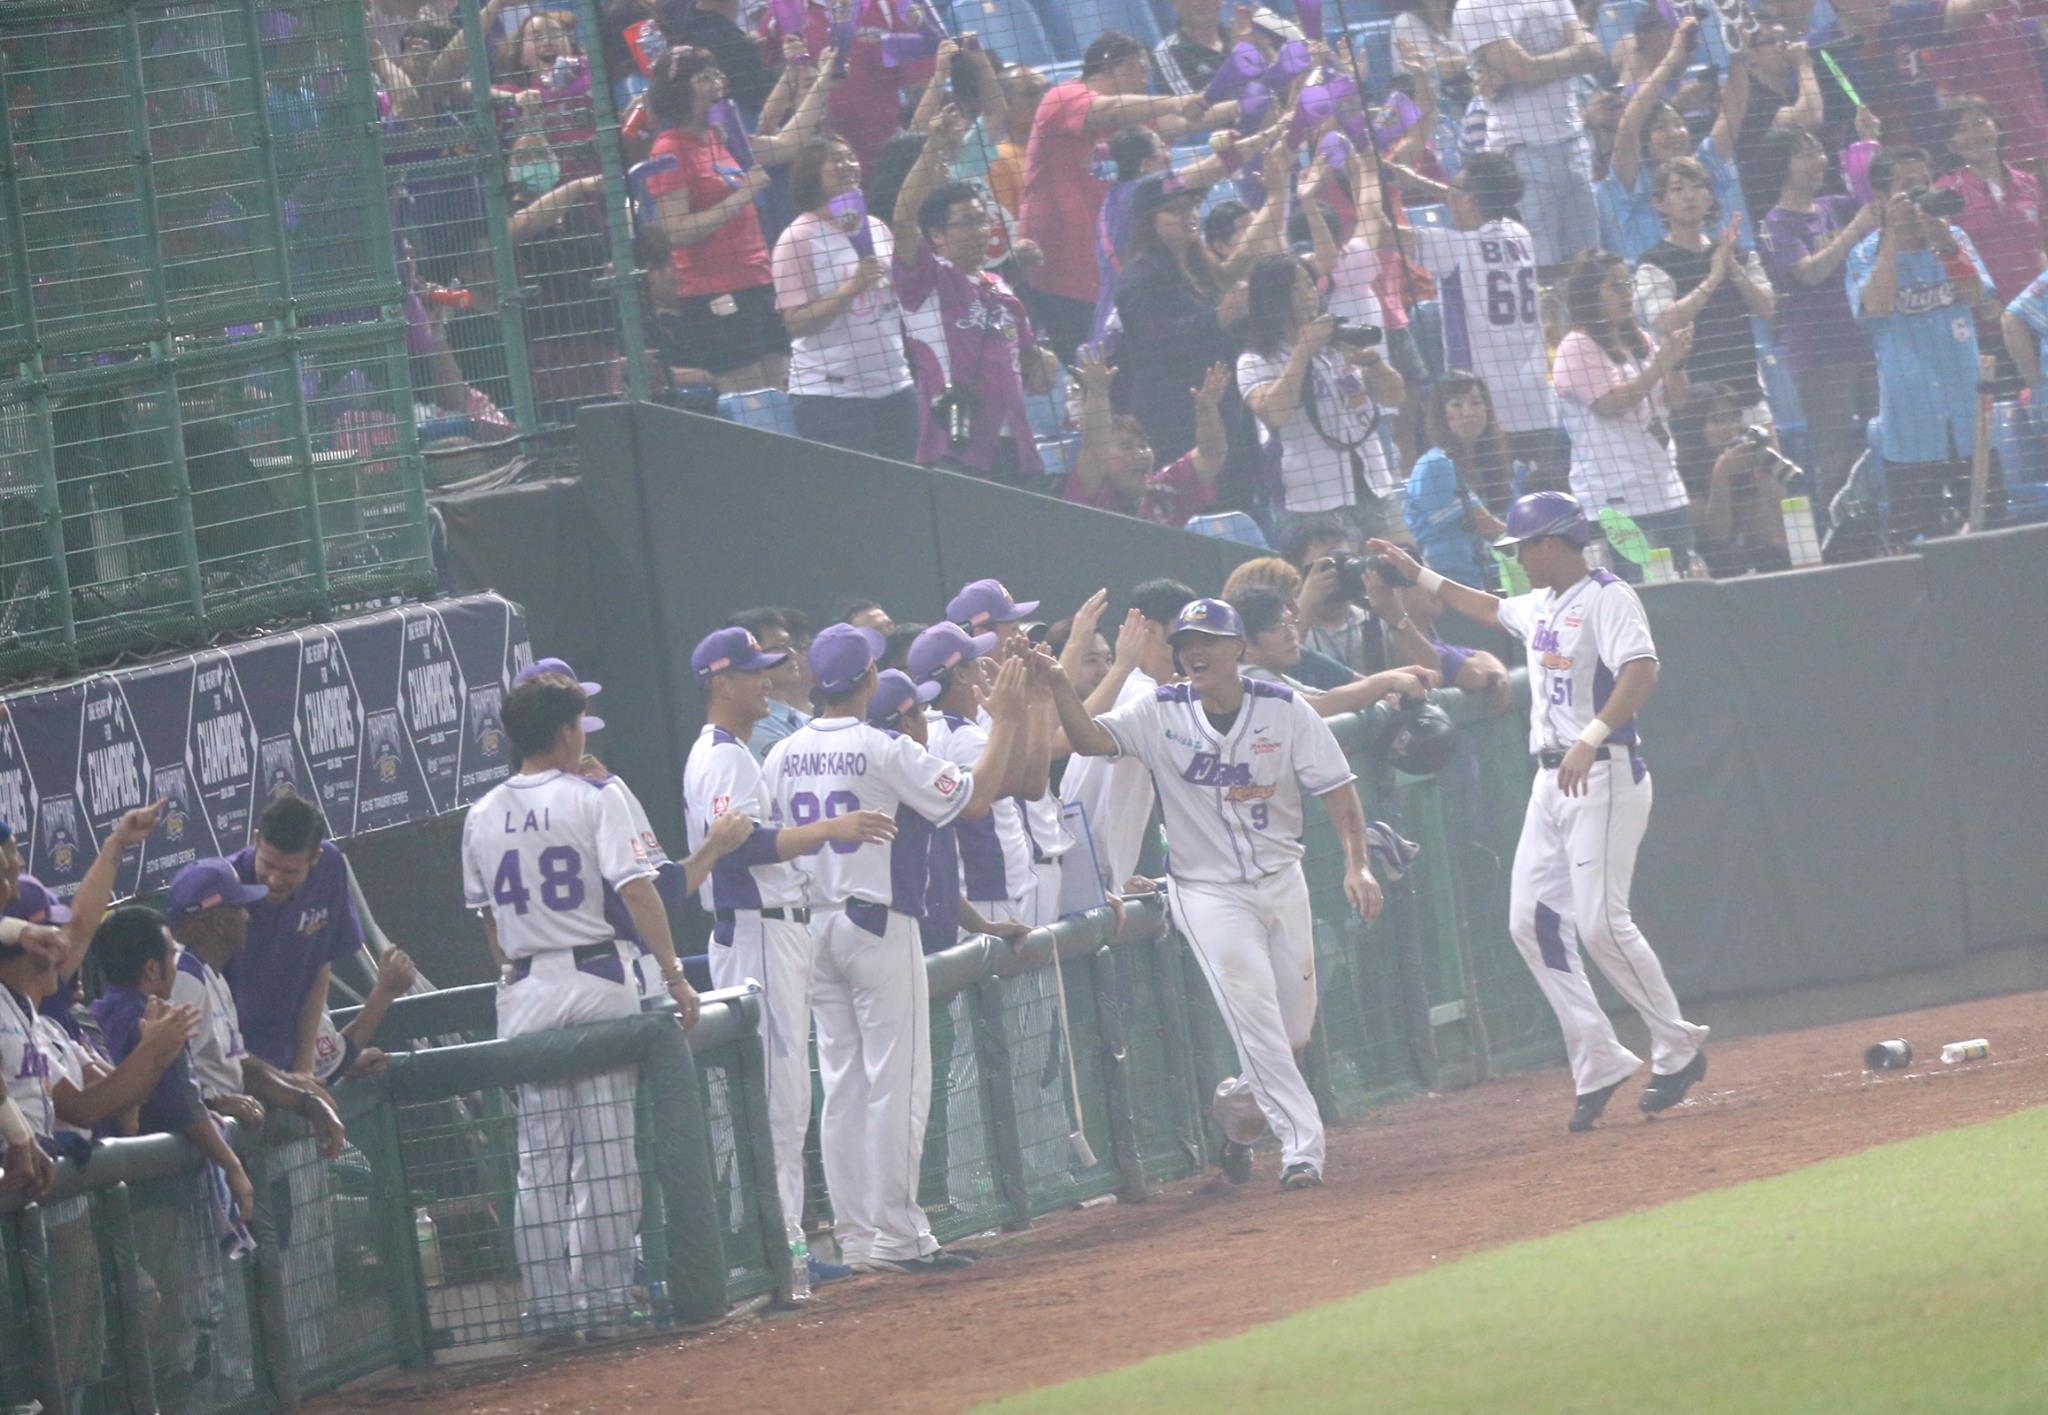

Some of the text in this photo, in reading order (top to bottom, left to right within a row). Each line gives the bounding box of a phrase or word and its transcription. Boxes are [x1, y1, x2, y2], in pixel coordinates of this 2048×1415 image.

[305, 685, 354, 755] CHAMPIONS
[408, 661, 457, 731] CHAMPIONS
[1551, 677, 1573, 707] 51
[88, 741, 141, 816] CHAMPIONS
[197, 712, 248, 785] CHAMPIONS
[783, 752, 867, 778] ARANGKARO
[505, 807, 550, 834] LAI
[1251, 802, 1269, 831] 9
[493, 845, 585, 915] 48
